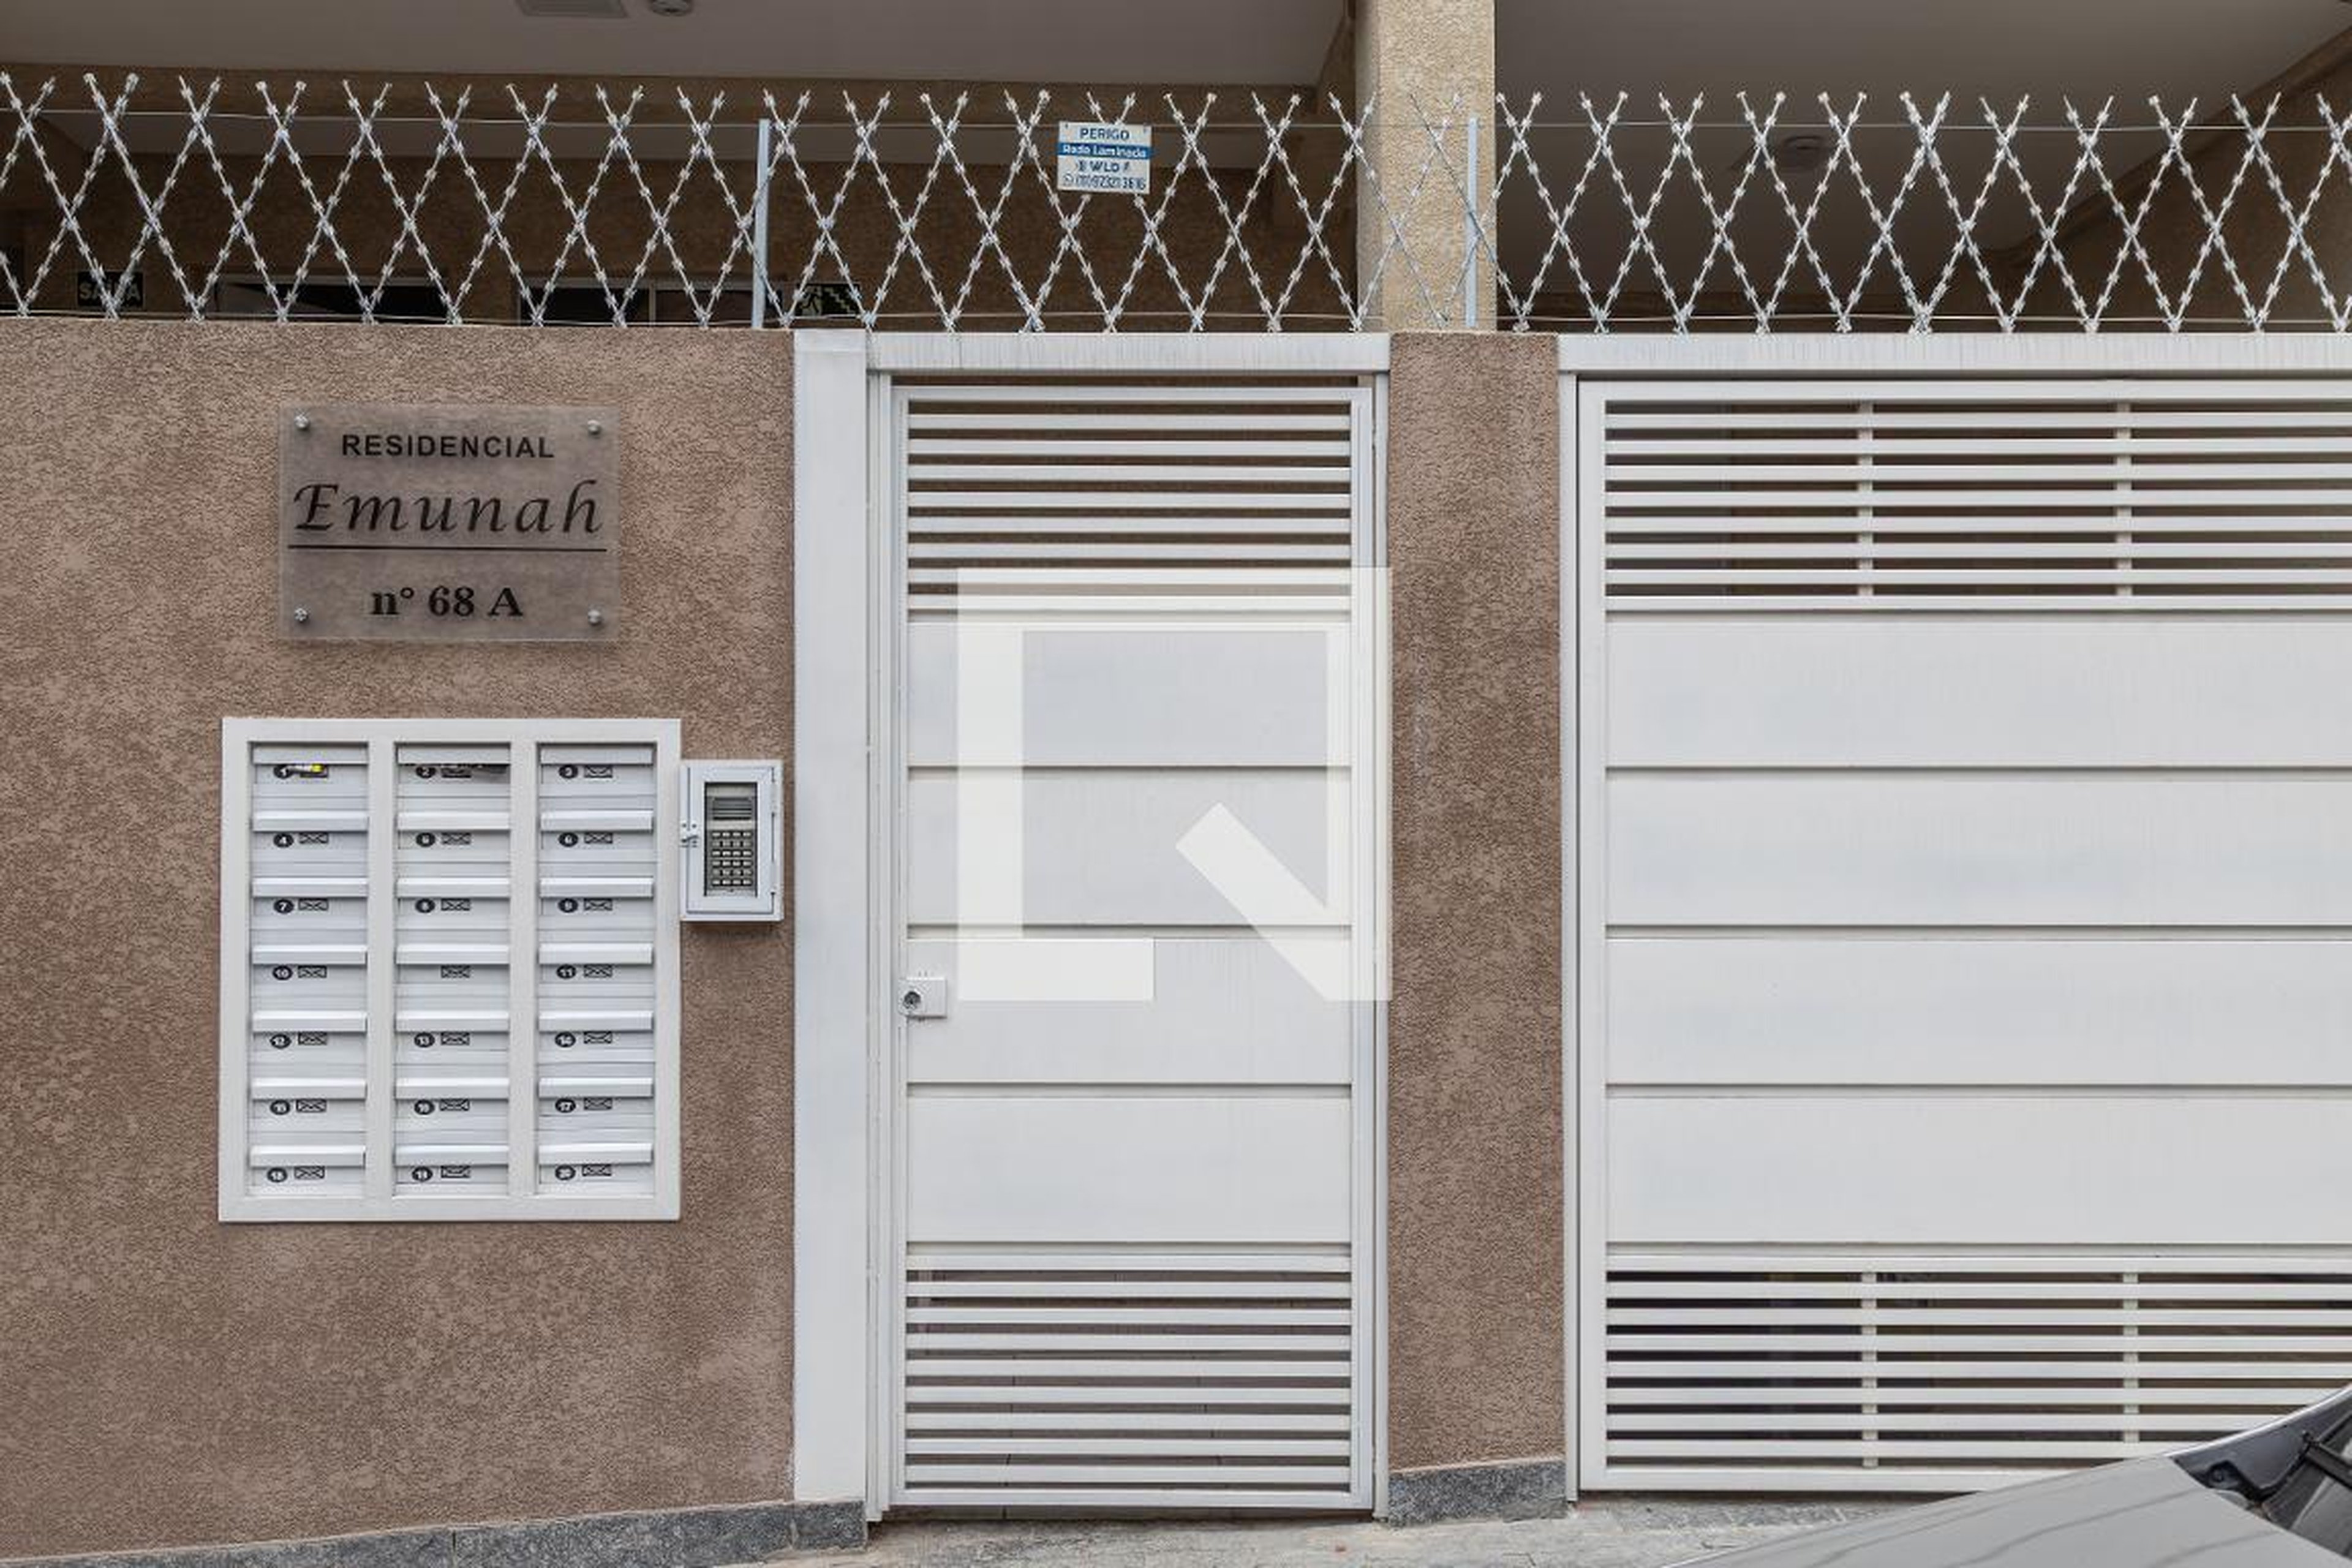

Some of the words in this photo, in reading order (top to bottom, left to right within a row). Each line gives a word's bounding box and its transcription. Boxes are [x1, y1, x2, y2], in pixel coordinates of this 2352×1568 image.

[1080, 127, 1129, 141] PERIGO
[341, 434, 555, 459] RESIDENCIAL
[293, 480, 603, 534] Emunah
[428, 585, 475, 617] 68
[488, 587, 524, 617] A
